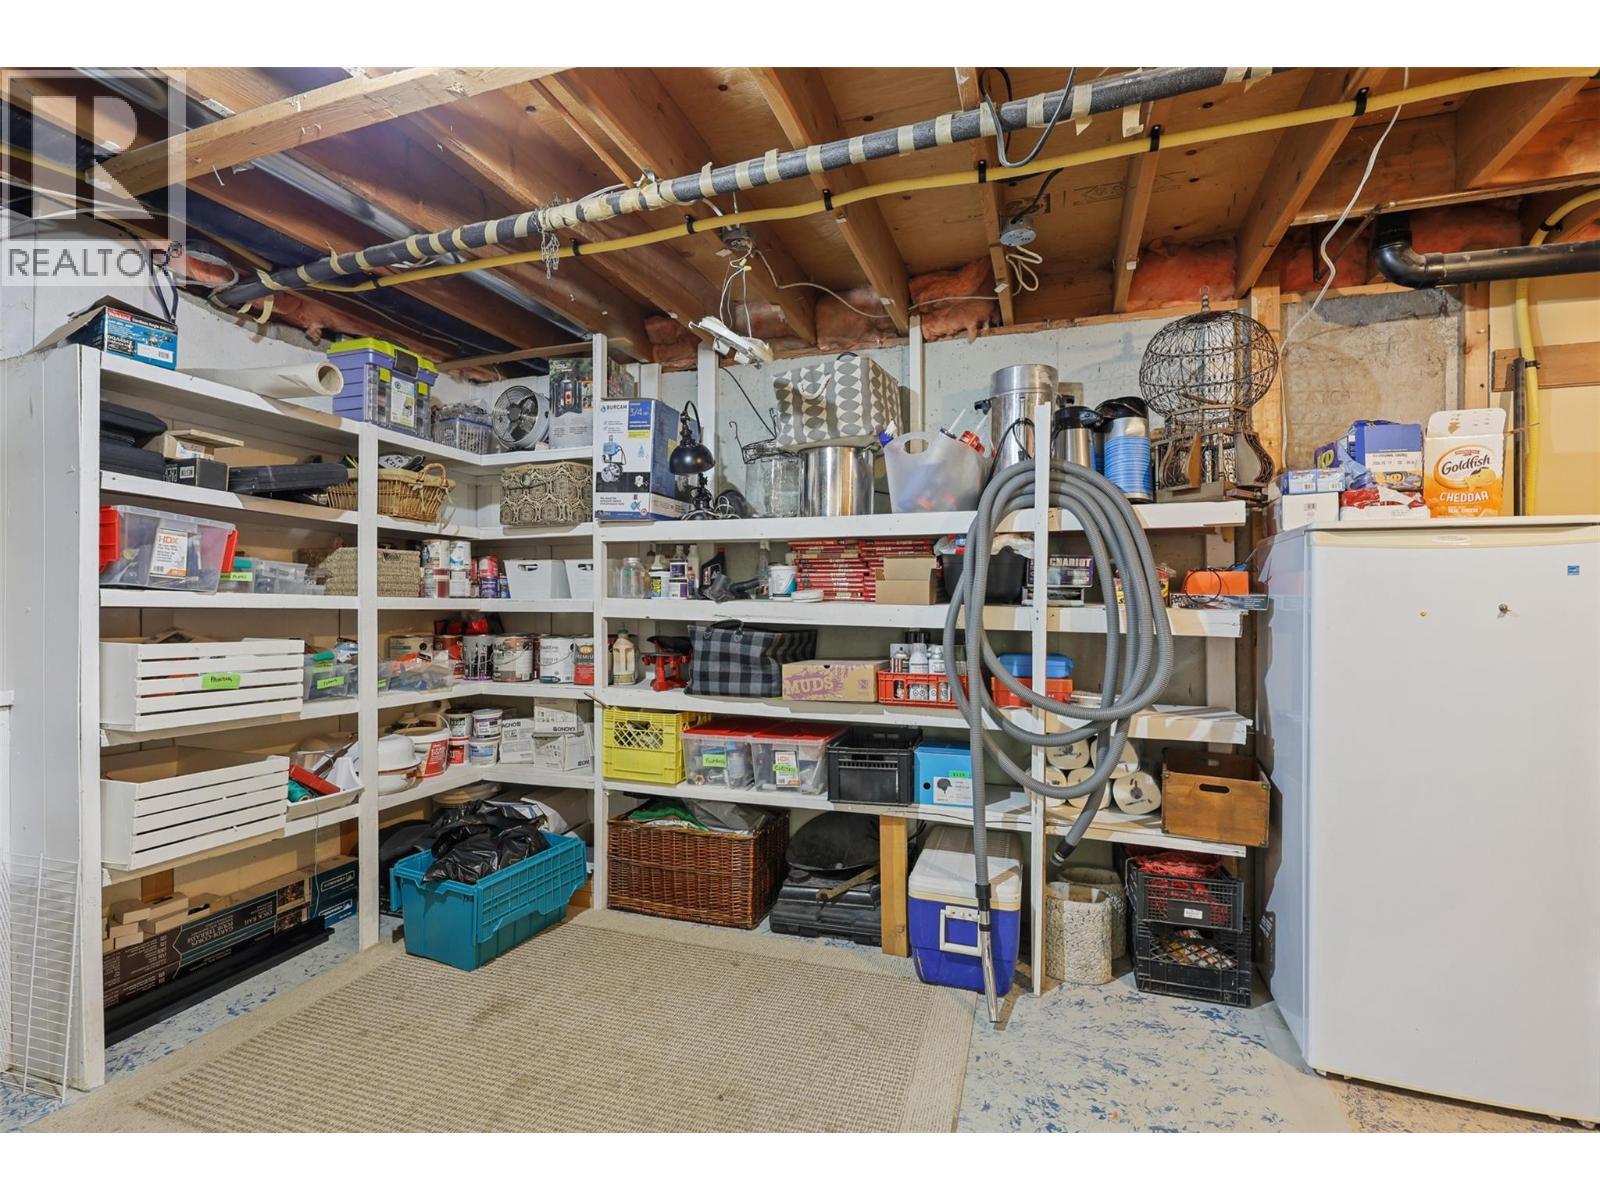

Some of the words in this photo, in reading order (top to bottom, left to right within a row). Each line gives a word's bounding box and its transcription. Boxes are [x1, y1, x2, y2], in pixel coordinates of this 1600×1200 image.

[1441, 454, 1490, 475] Goldfish
[1440, 490, 1489, 502] CHEDDAR
[1049, 557, 1091, 567] CHARIOT
[785, 676, 833, 695] MUDS
